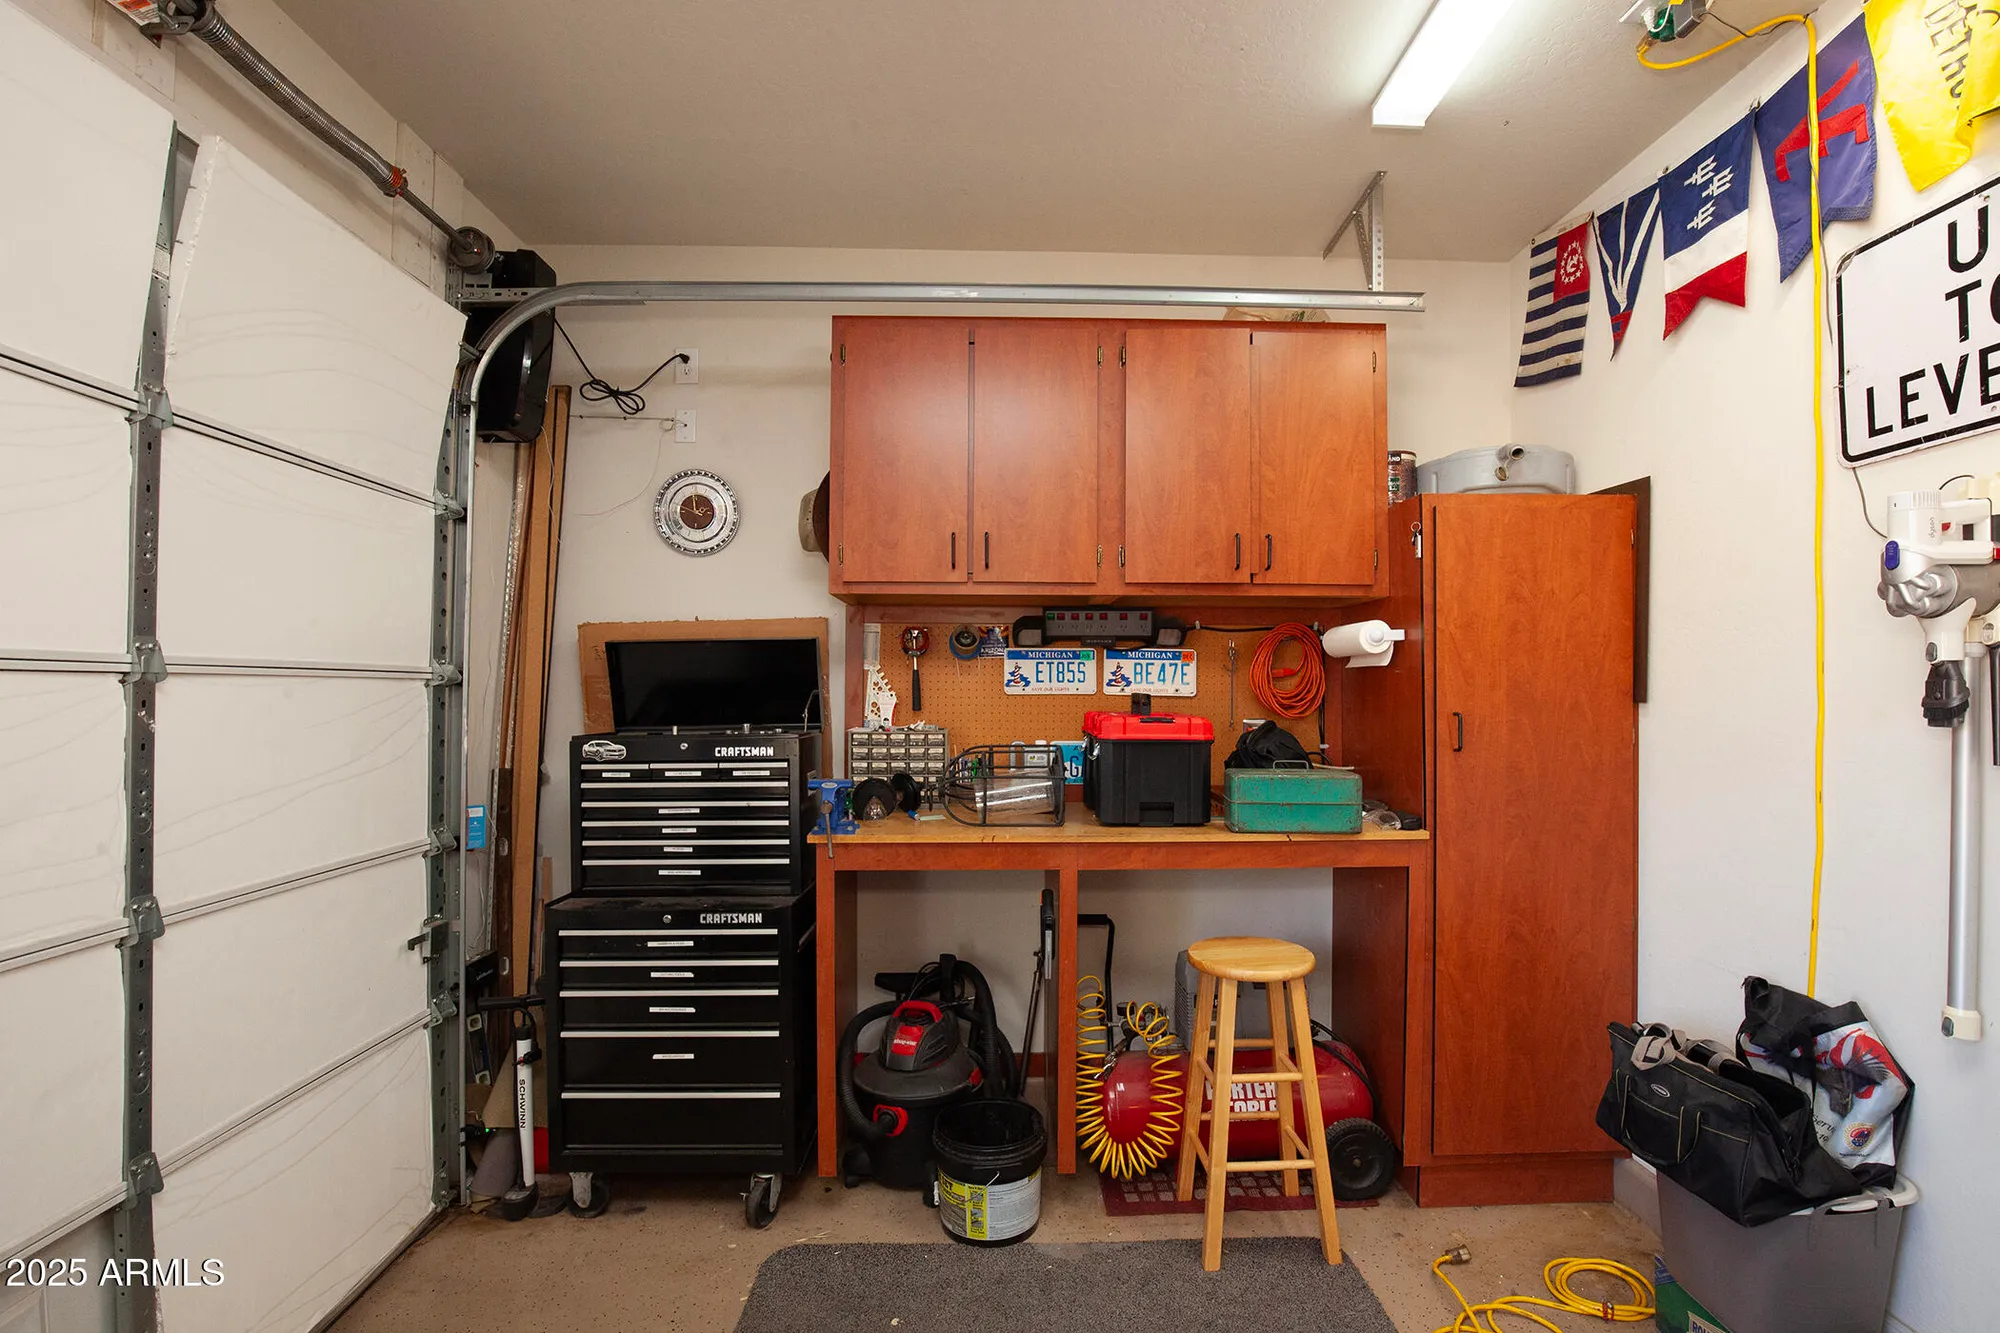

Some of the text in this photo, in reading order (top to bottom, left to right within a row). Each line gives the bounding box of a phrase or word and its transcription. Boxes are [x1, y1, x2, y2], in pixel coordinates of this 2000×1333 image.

[1924, 0, 1972, 109] DETR
[1945, 273, 2000, 343] T
[1928, 516, 1937, 539] dyson
[981, 646, 1004, 655] ARIZON
[1028, 651, 1073, 659] MICHIGAN
[1128, 651, 1173, 659] MICHIGAN
[1133, 662, 1190, 686] BE47E
[714, 746, 774, 757] CRAFTSMAN
[700, 912, 763, 924] CRAFTSMAN
